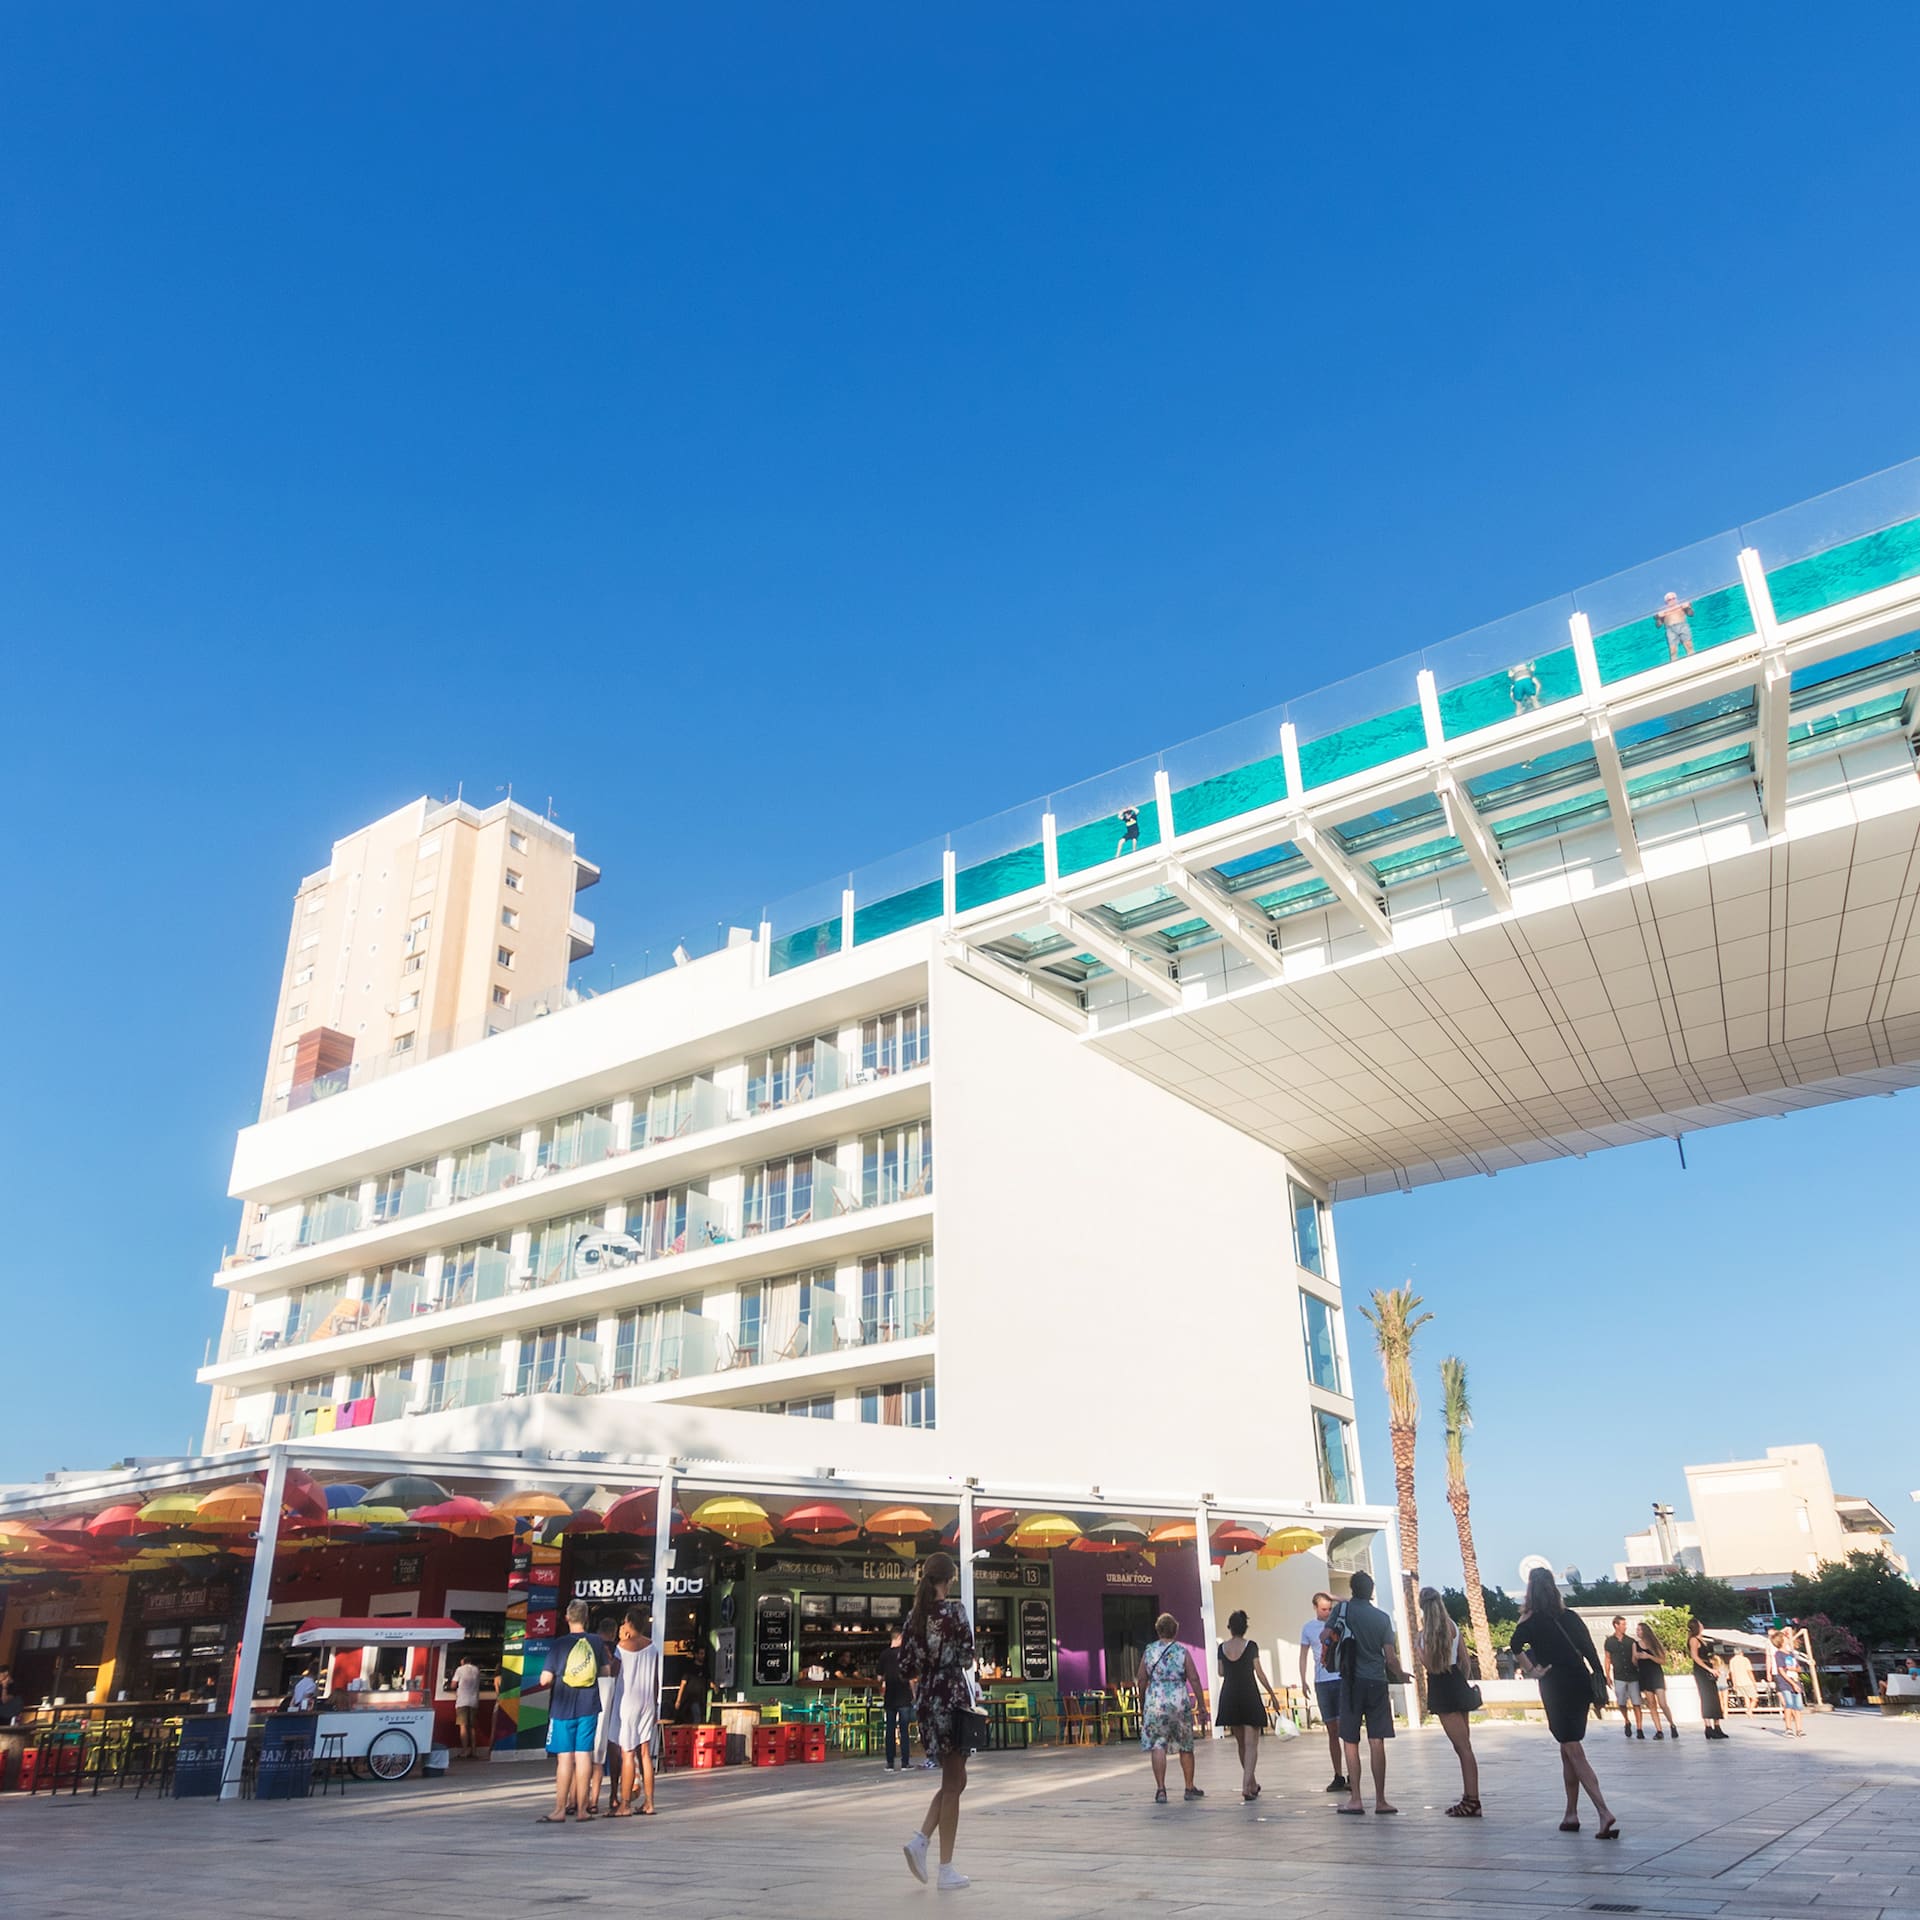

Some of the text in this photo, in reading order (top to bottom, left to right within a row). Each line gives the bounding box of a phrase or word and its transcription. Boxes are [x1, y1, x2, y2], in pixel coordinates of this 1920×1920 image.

[863, 1561, 876, 1579] EL
[879, 1562, 901, 1580] BAR
[975, 1570, 988, 1580] EER
[1026, 1569, 1038, 1583] 13
[1106, 1573, 1132, 1583] URBAN
[574, 1576, 703, 1598] URBAN OOD
[616, 1595, 653, 1603] MALLORC
[176, 1749, 218, 1761] RBAN
[260, 1750, 287, 1762] BAN
